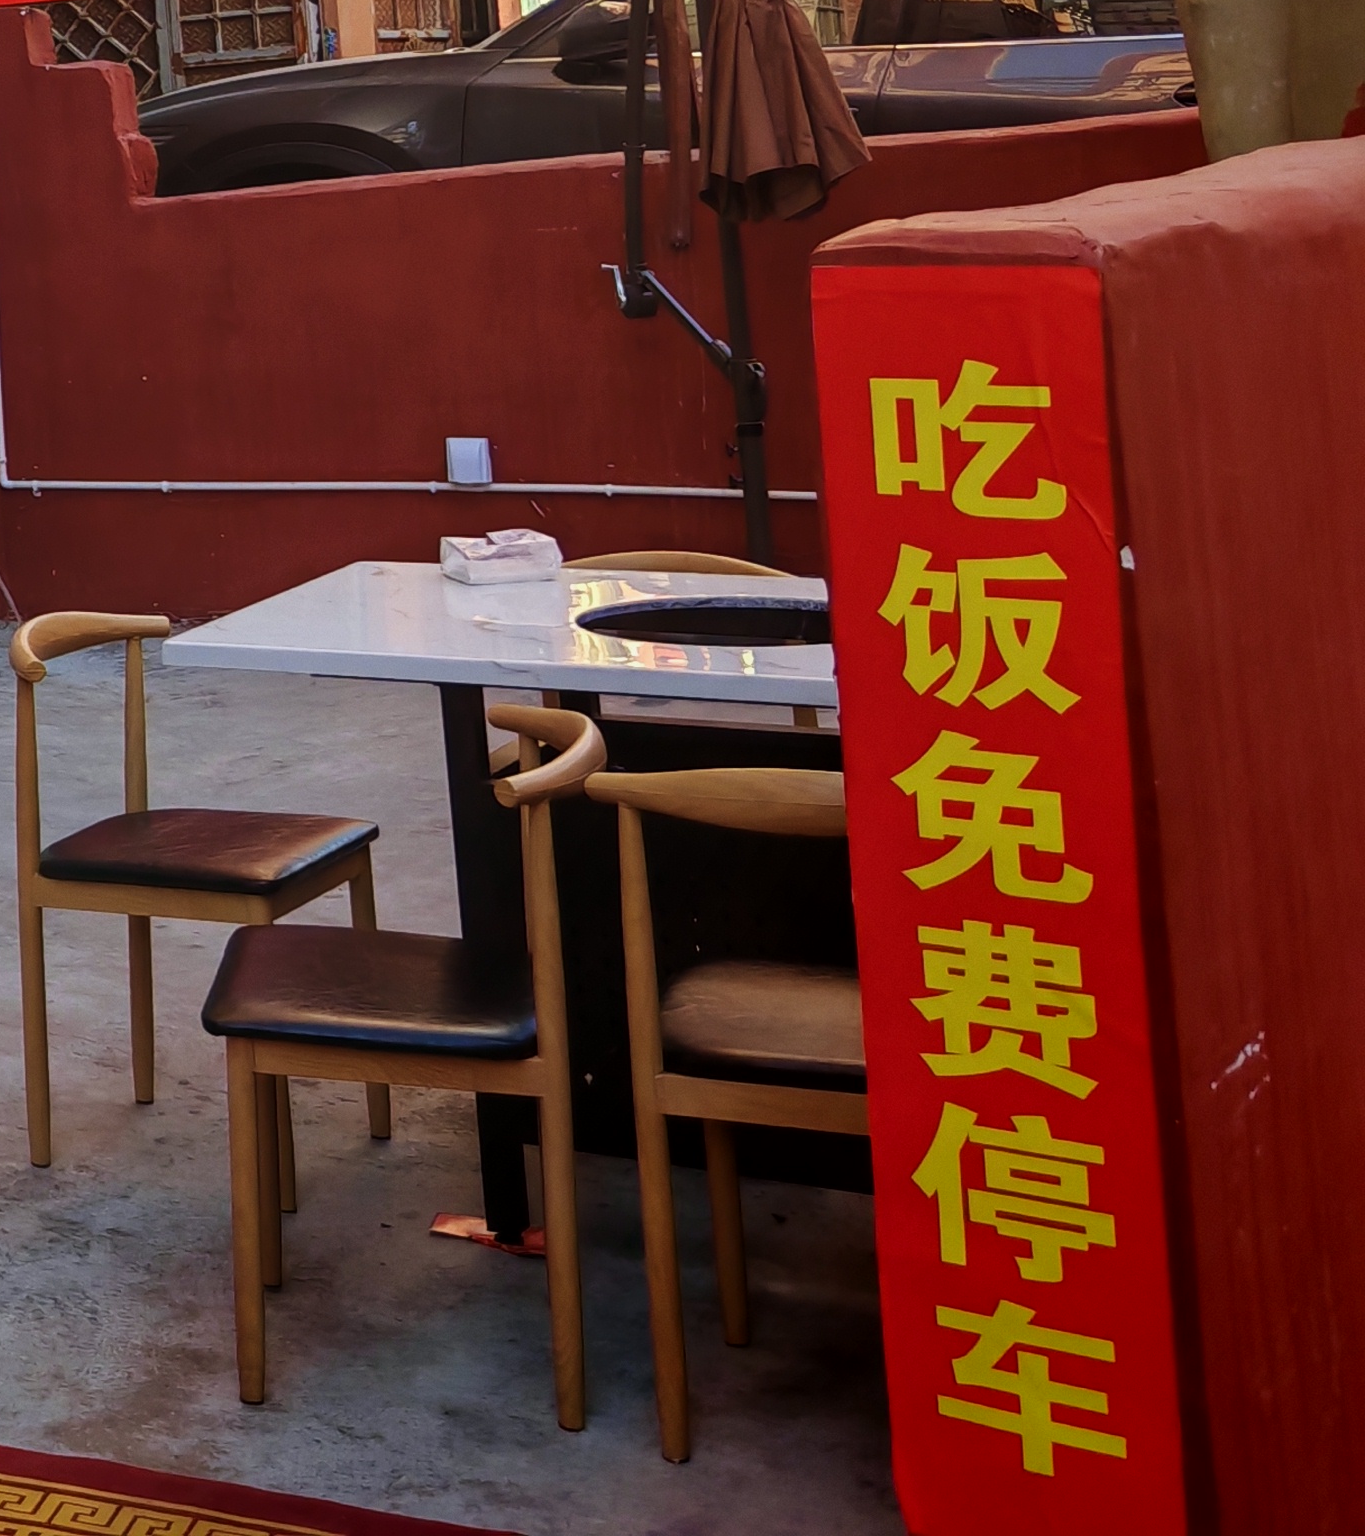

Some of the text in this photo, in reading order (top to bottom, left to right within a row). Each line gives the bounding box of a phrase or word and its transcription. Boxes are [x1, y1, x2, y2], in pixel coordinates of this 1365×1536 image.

[869, 360, 1128, 1476] 吃饭免费停车
